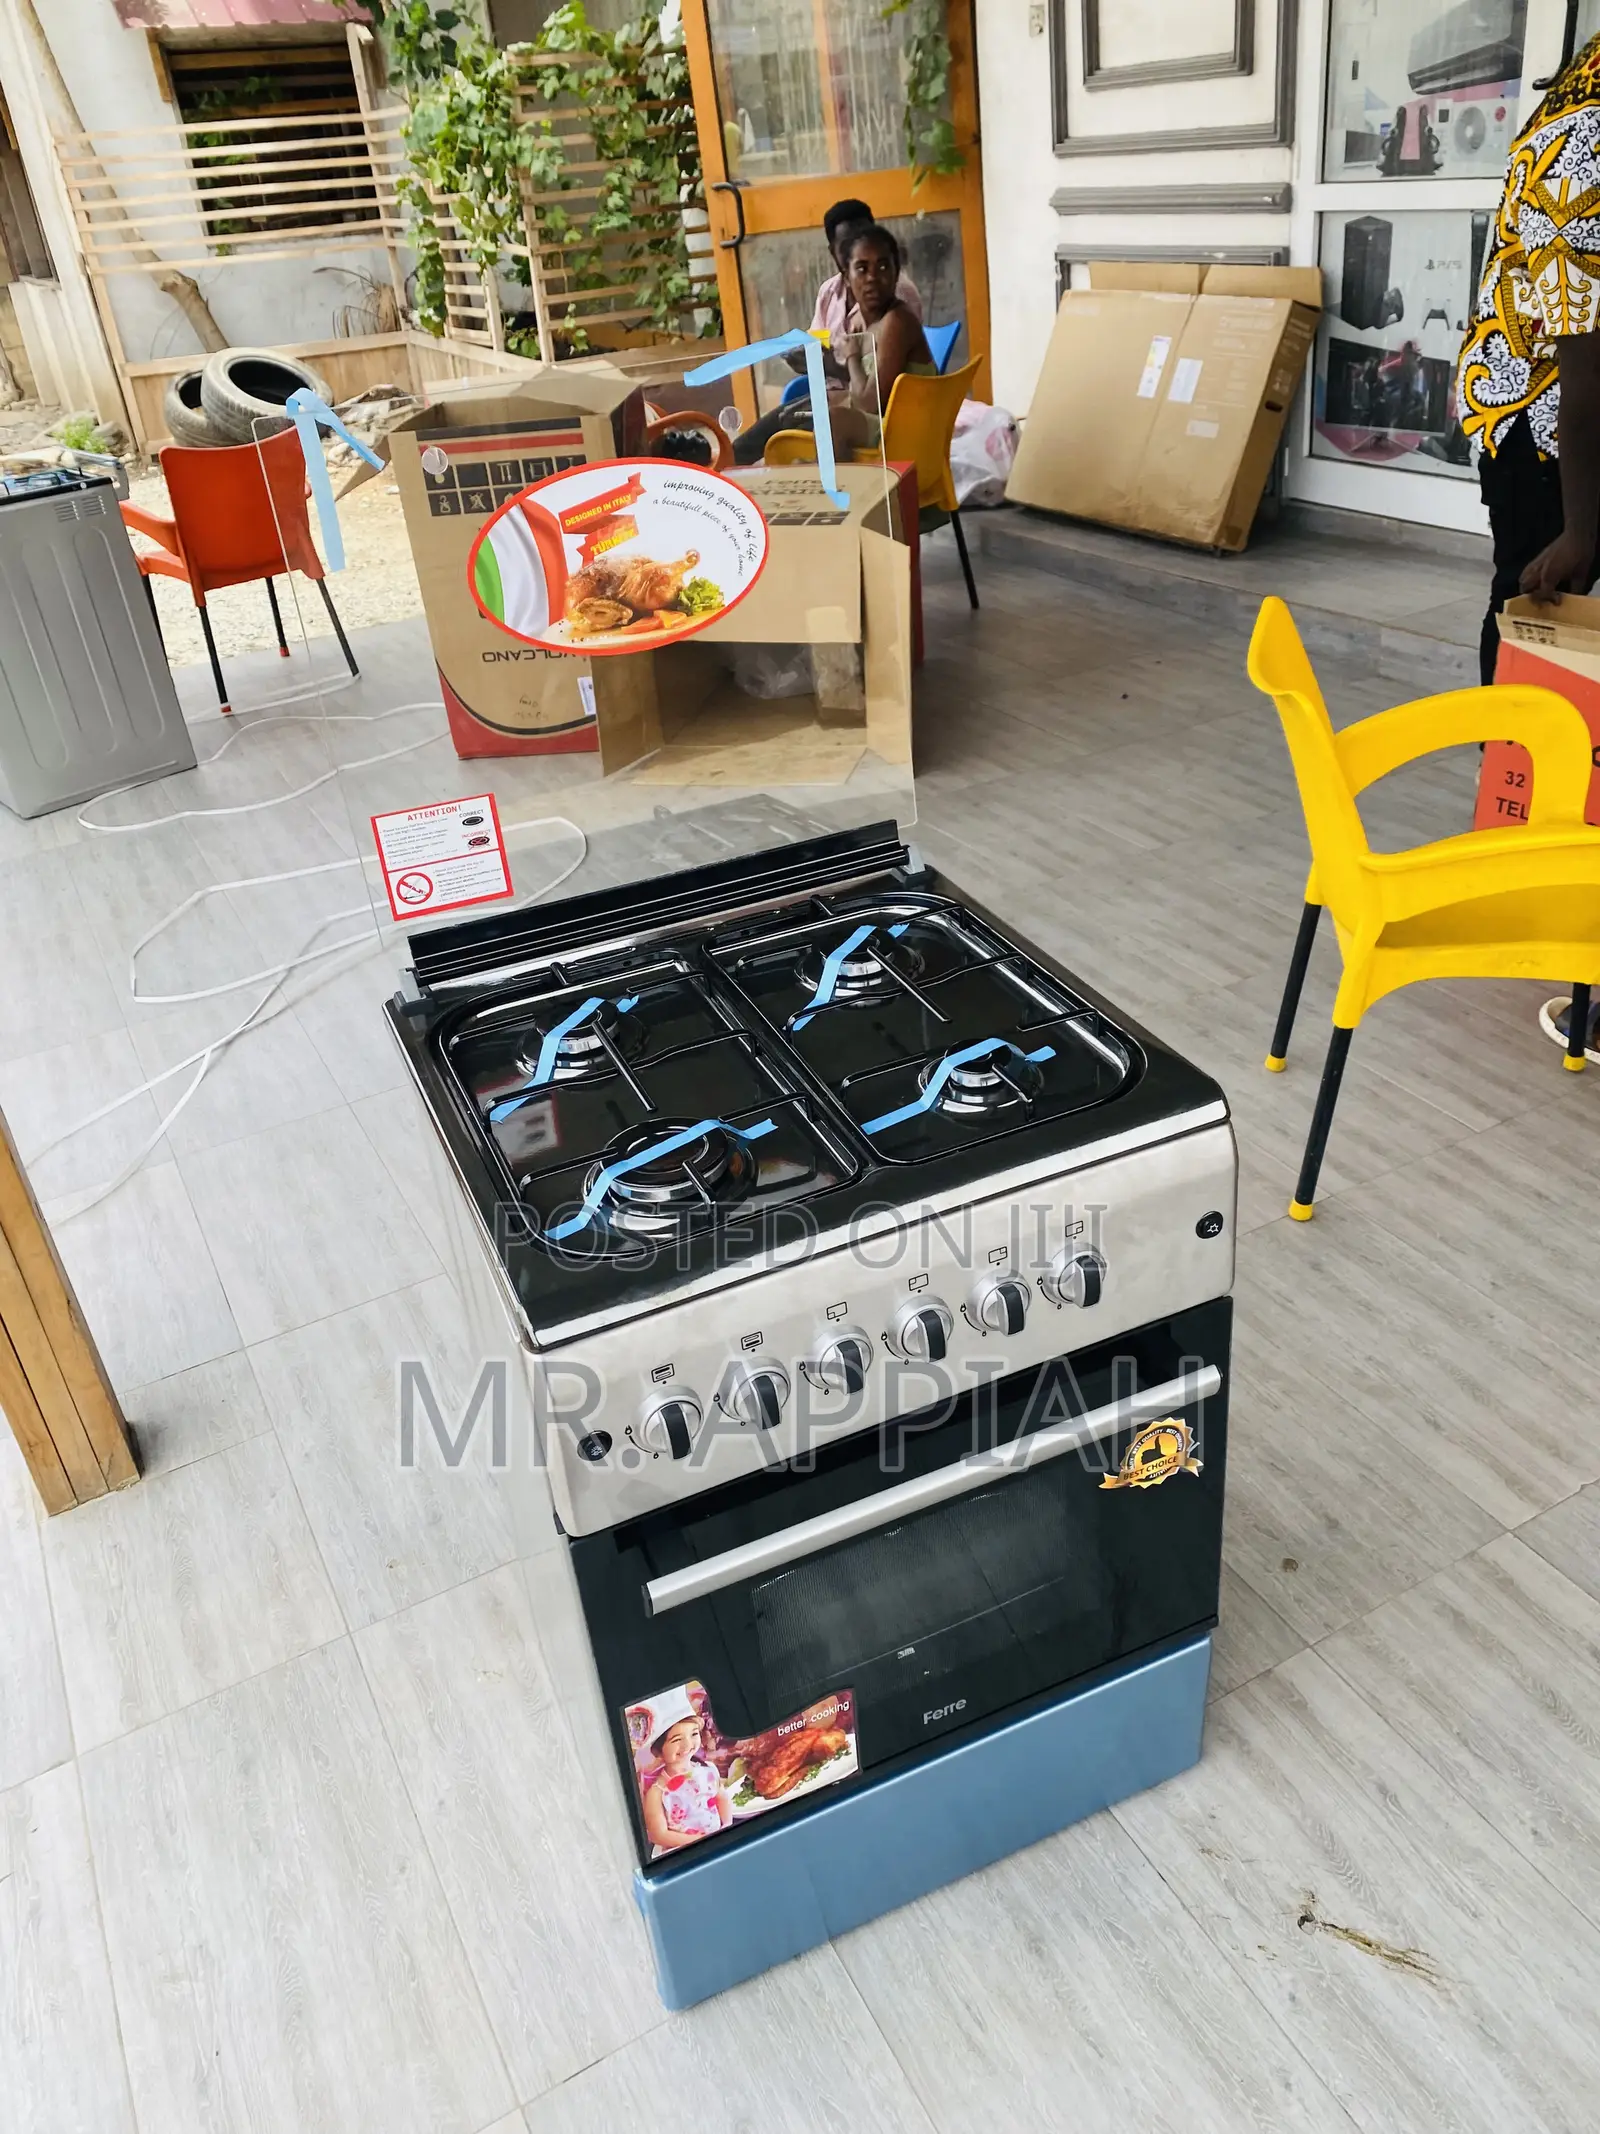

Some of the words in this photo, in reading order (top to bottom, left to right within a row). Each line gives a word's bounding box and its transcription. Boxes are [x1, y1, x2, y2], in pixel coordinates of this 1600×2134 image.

[663, 479, 715, 500] improving
[564, 506, 603, 527] DESIGNED
[602, 502, 612, 512] IN
[612, 493, 632, 508] ITALY
[661, 496, 703, 513] beautifull
[716, 496, 748, 526] quality
[743, 528, 756, 540] of
[746, 543, 759, 562] life
[1504, 770, 1526, 788] 32
[407, 805, 461, 821] ATTENTION!
[1495, 796, 1529, 821] TEL
[1123, 1468, 1144, 1480] BEST
[1146, 1455, 1177, 1472] CHOICE
[776, 1716, 808, 1737] better
[809, 1700, 850, 1723] cooking
[922, 1697, 967, 1725] Ferre
